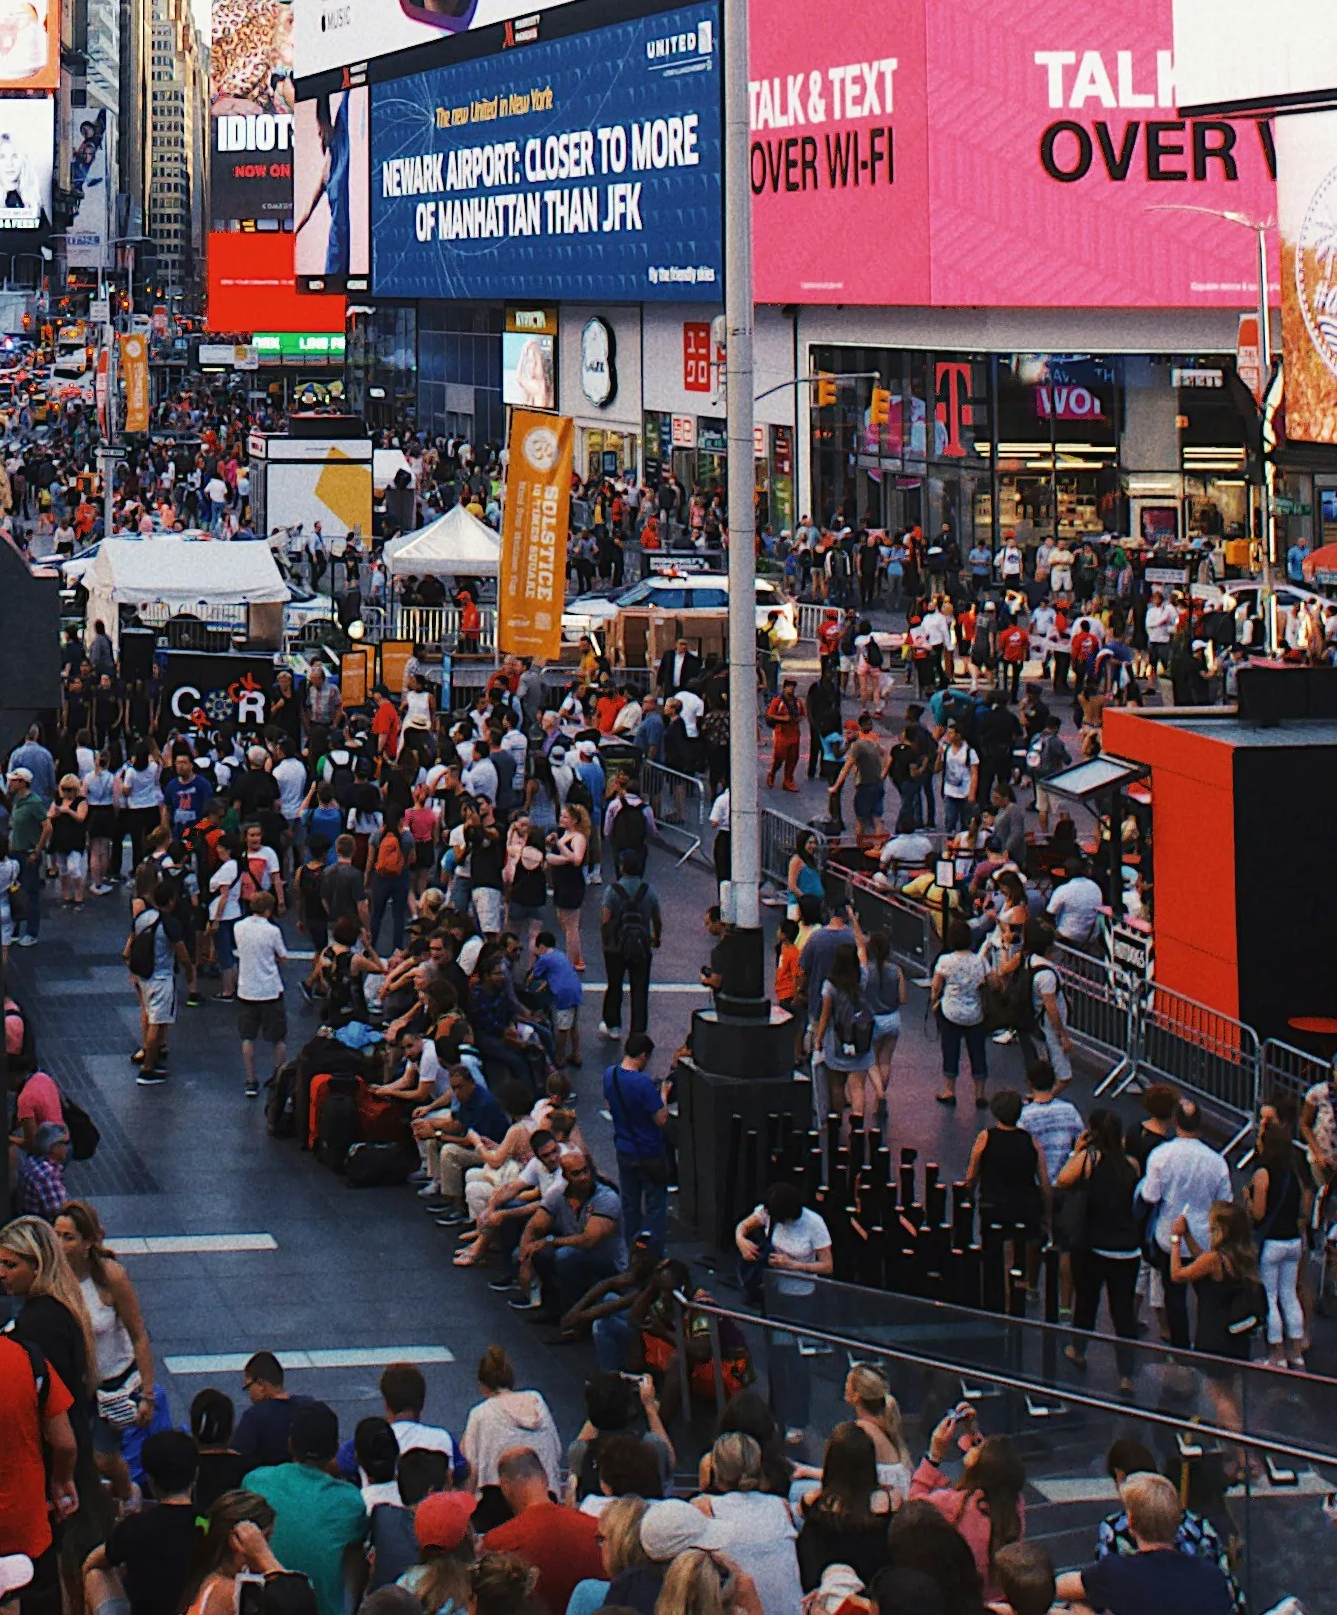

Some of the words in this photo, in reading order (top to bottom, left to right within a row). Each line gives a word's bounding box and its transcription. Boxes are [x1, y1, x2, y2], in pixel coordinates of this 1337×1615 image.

[647, 31, 697, 59] UNITED
[509, 94, 530, 115] New
[531, 85, 553, 112] York
[747, 73, 806, 131] TALK
[808, 70, 826, 124] &
[828, 57, 898, 120] TEXT
[217, 114, 295, 152] IDIOT
[382, 153, 444, 198] NEWARK
[446, 142, 521, 190] AIRPORT:
[525, 126, 595, 182] CLOSER
[597, 125, 628, 174] TO
[631, 114, 699, 170] MORE
[750, 136, 818, 195] OVER
[825, 126, 894, 189] WI-FI
[1039, 119, 1239, 183] OVER
[234, 165, 267, 178] NOW
[270, 164, 291, 179] ON
[416, 201, 437, 242] OF
[438, 192, 541, 240] MANHATTAN
[545, 186, 599, 235] THAN
[603, 182, 643, 233] JFK
[537, 484, 559, 601] SOLSTICE
